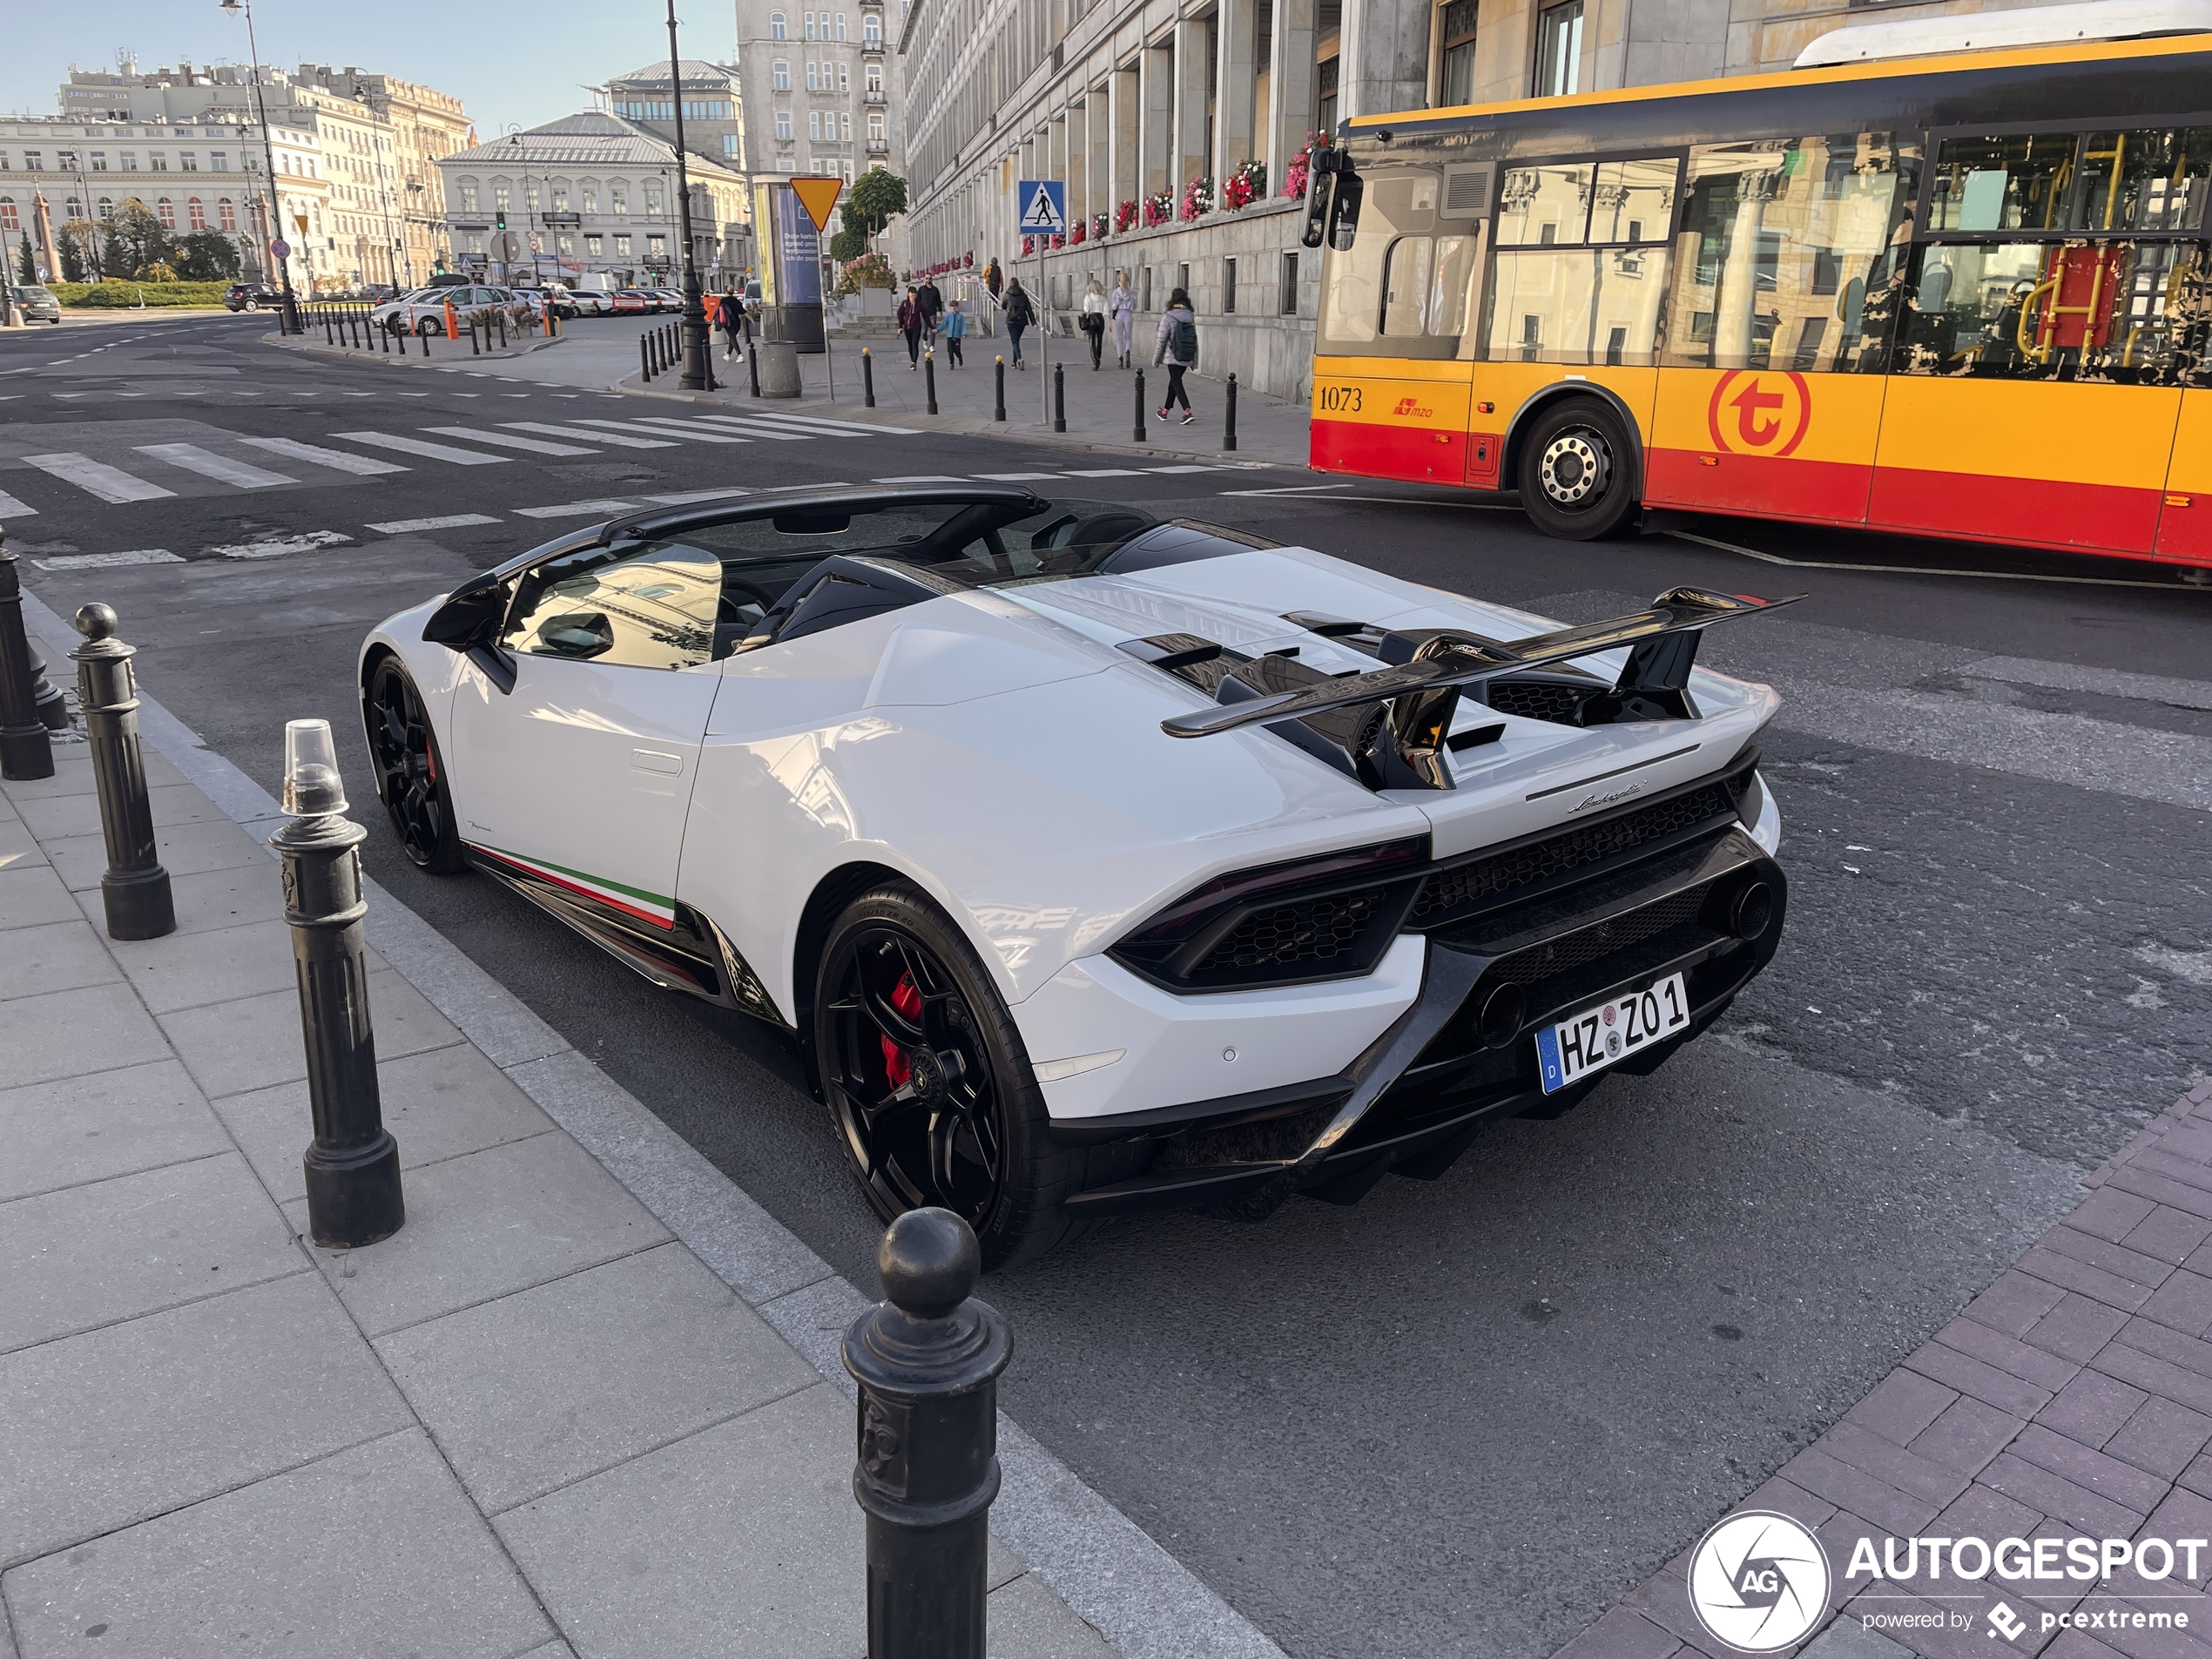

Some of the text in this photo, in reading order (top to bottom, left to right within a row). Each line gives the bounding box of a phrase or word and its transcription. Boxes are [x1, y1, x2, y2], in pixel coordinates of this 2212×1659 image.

[1320, 386, 1362, 412] 1073
[886, 910, 900, 920] ZR
[901, 916, 914, 927] 20
[1560, 1015, 1604, 1076] HZ
[1664, 980, 1684, 1027] 1
[1548, 1064, 1556, 1079] D
